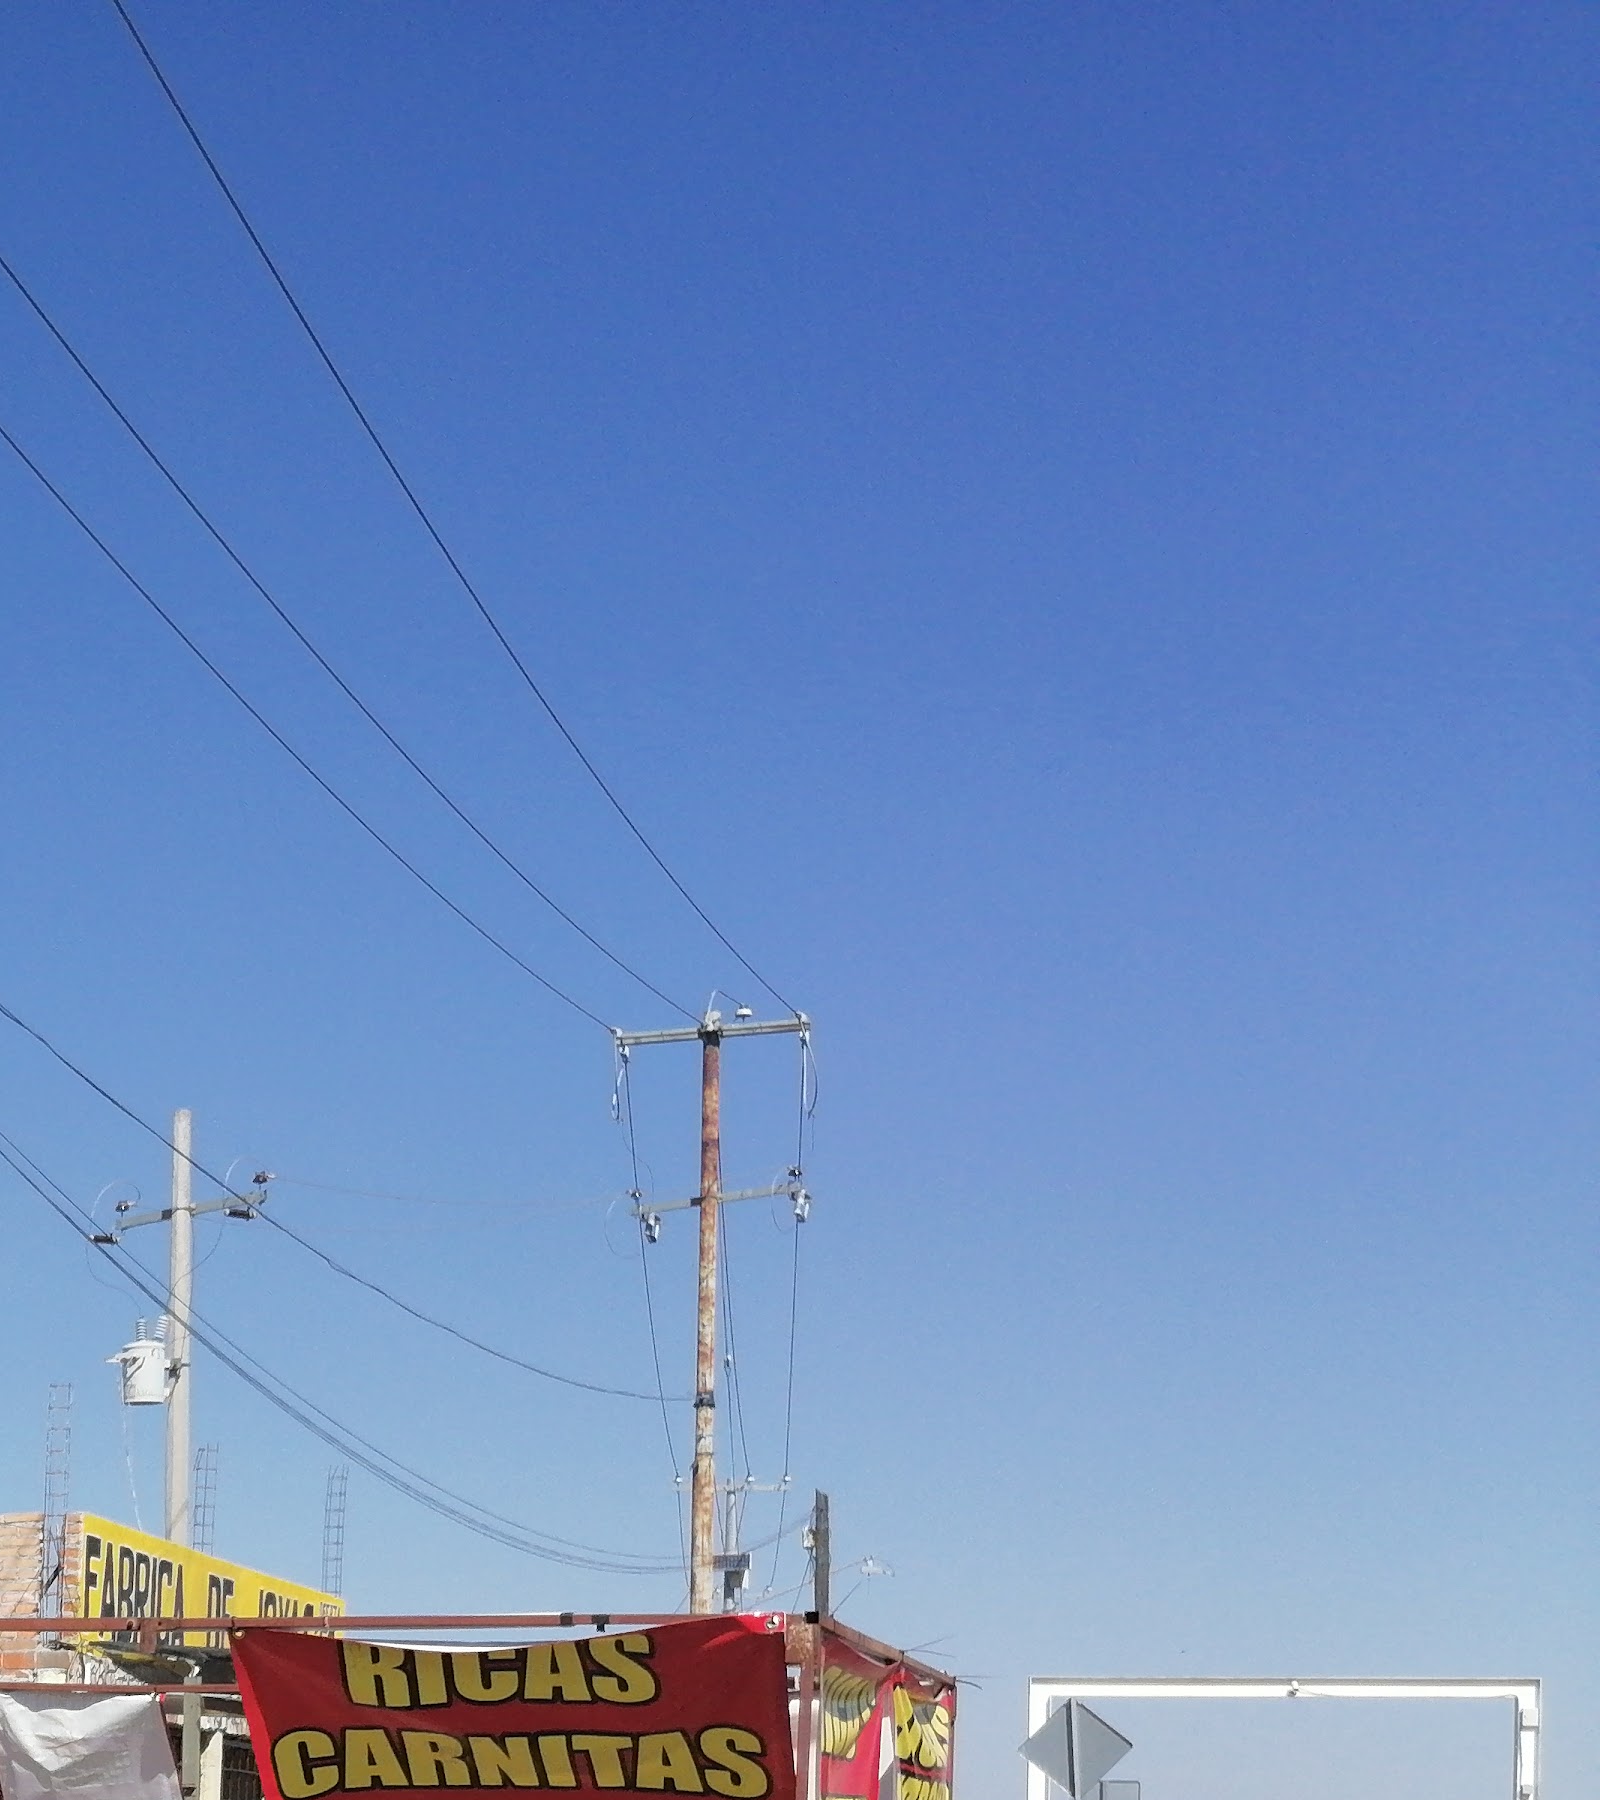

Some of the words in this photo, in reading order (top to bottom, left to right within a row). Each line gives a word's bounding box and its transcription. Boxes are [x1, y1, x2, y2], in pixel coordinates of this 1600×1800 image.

[83, 1534, 185, 1646] FABRICA
[342, 1634, 657, 1710] RICAS
[273, 1726, 770, 1800] CARNITAS
